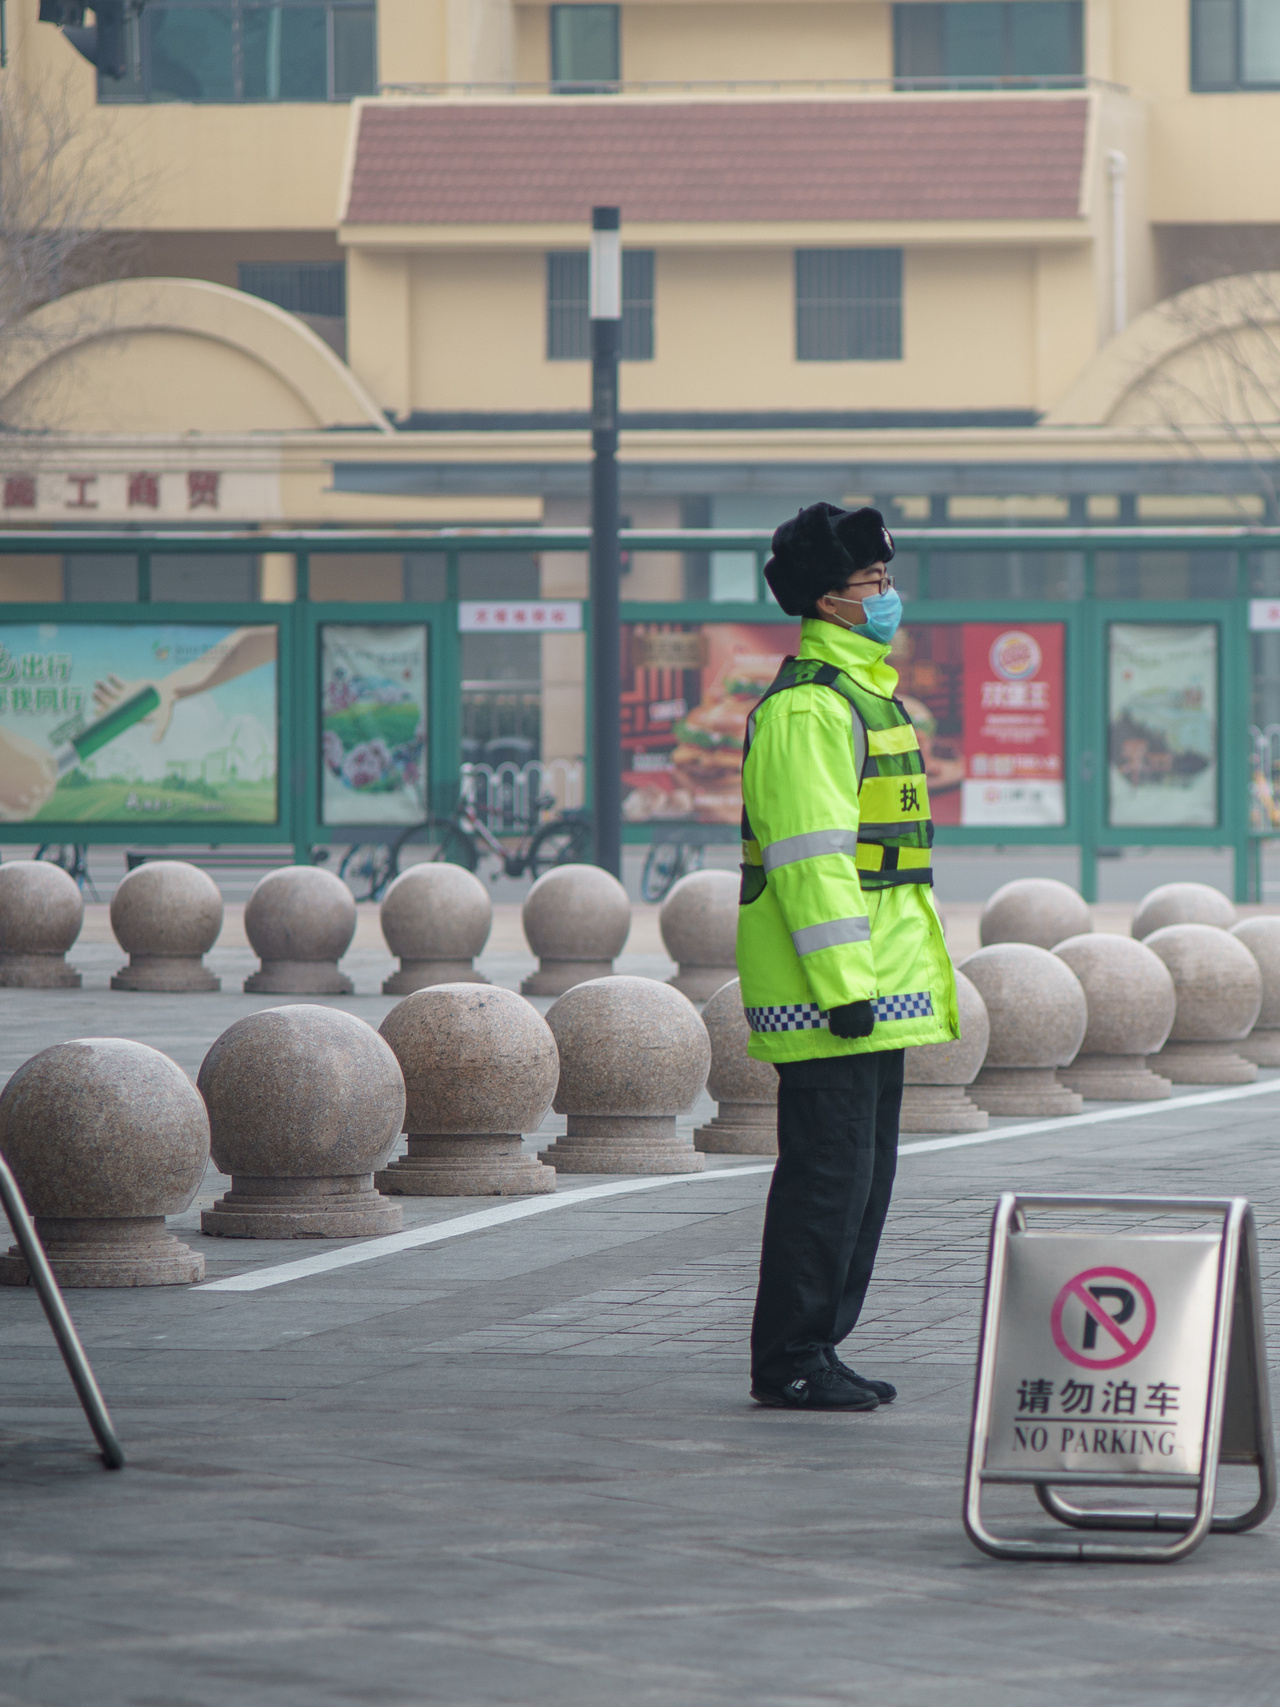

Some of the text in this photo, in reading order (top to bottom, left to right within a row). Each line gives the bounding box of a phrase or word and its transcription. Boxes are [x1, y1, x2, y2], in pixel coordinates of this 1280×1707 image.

[900, 782, 920, 812] 执
[1016, 1378, 1181, 1418] 请勿泊车
[1013, 1426, 1176, 1457] NO PARKING
